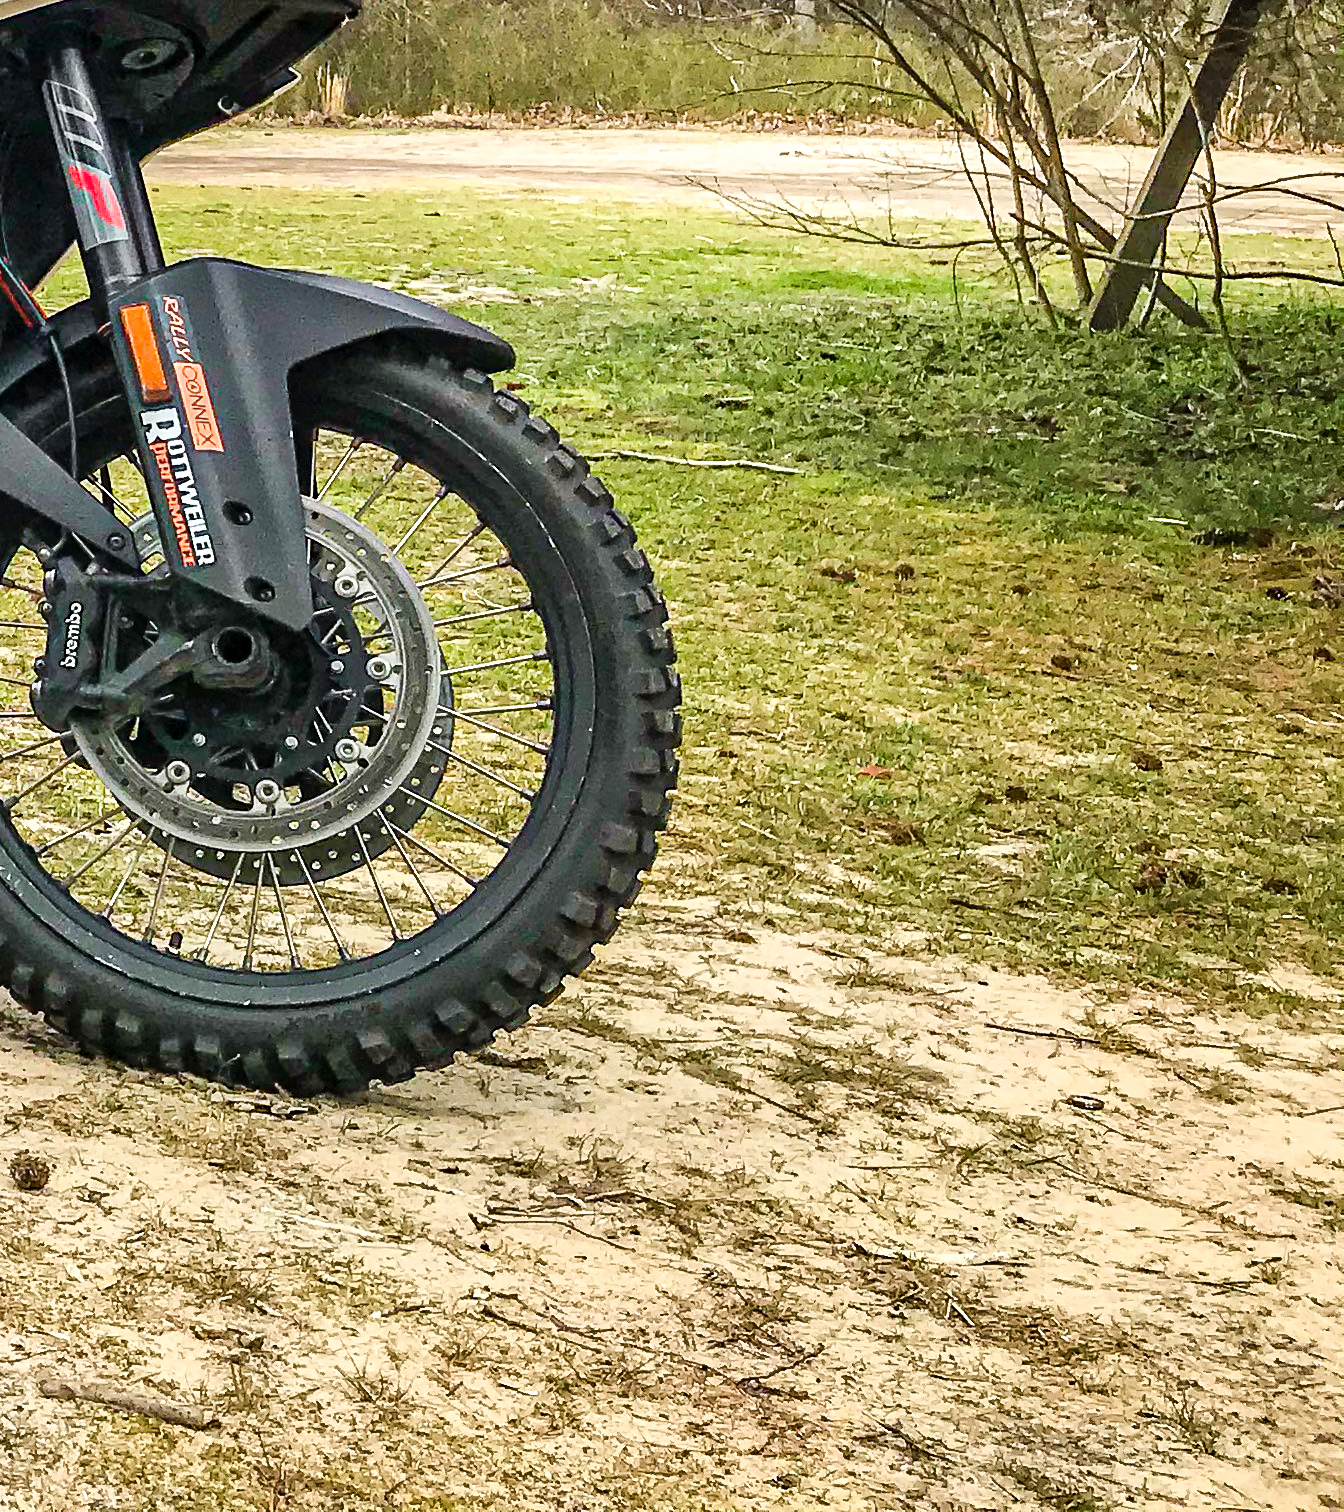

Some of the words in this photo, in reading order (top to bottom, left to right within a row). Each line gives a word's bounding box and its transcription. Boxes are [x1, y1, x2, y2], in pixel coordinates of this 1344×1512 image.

[163, 296, 194, 363] RALLY
[182, 365, 217, 446] CONNEX
[140, 407, 215, 566] ROTTWEILER
[149, 442, 196, 568] PERFORMANCE
[60, 602, 82, 668] brembo
